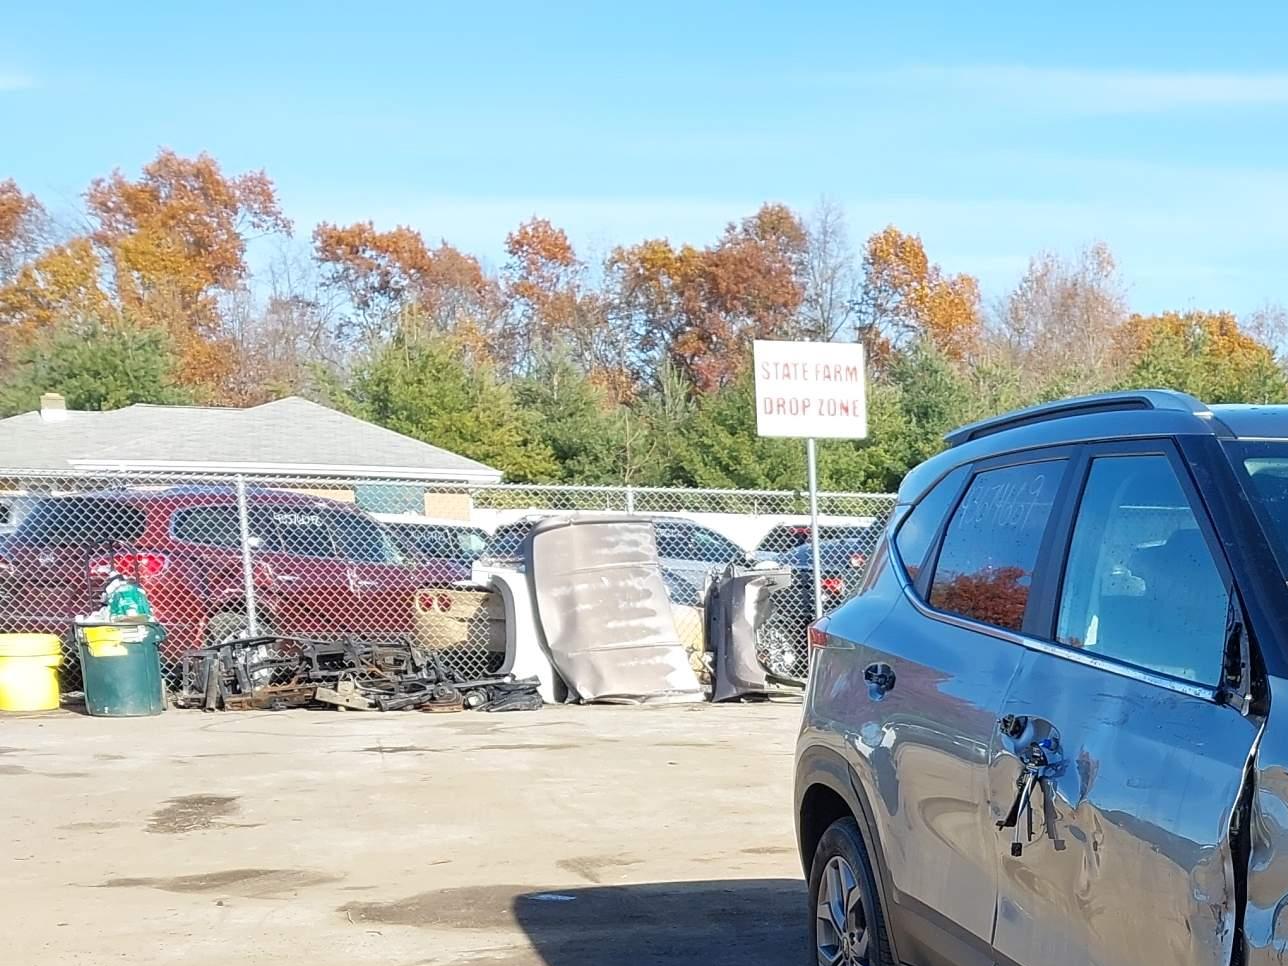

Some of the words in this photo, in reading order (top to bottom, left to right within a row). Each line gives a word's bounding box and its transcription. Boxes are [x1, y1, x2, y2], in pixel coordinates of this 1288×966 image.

[761, 361, 809, 381] STATE
[815, 364, 859, 384] FARM
[763, 397, 811, 416] DROP
[818, 398, 860, 418] ZONE
